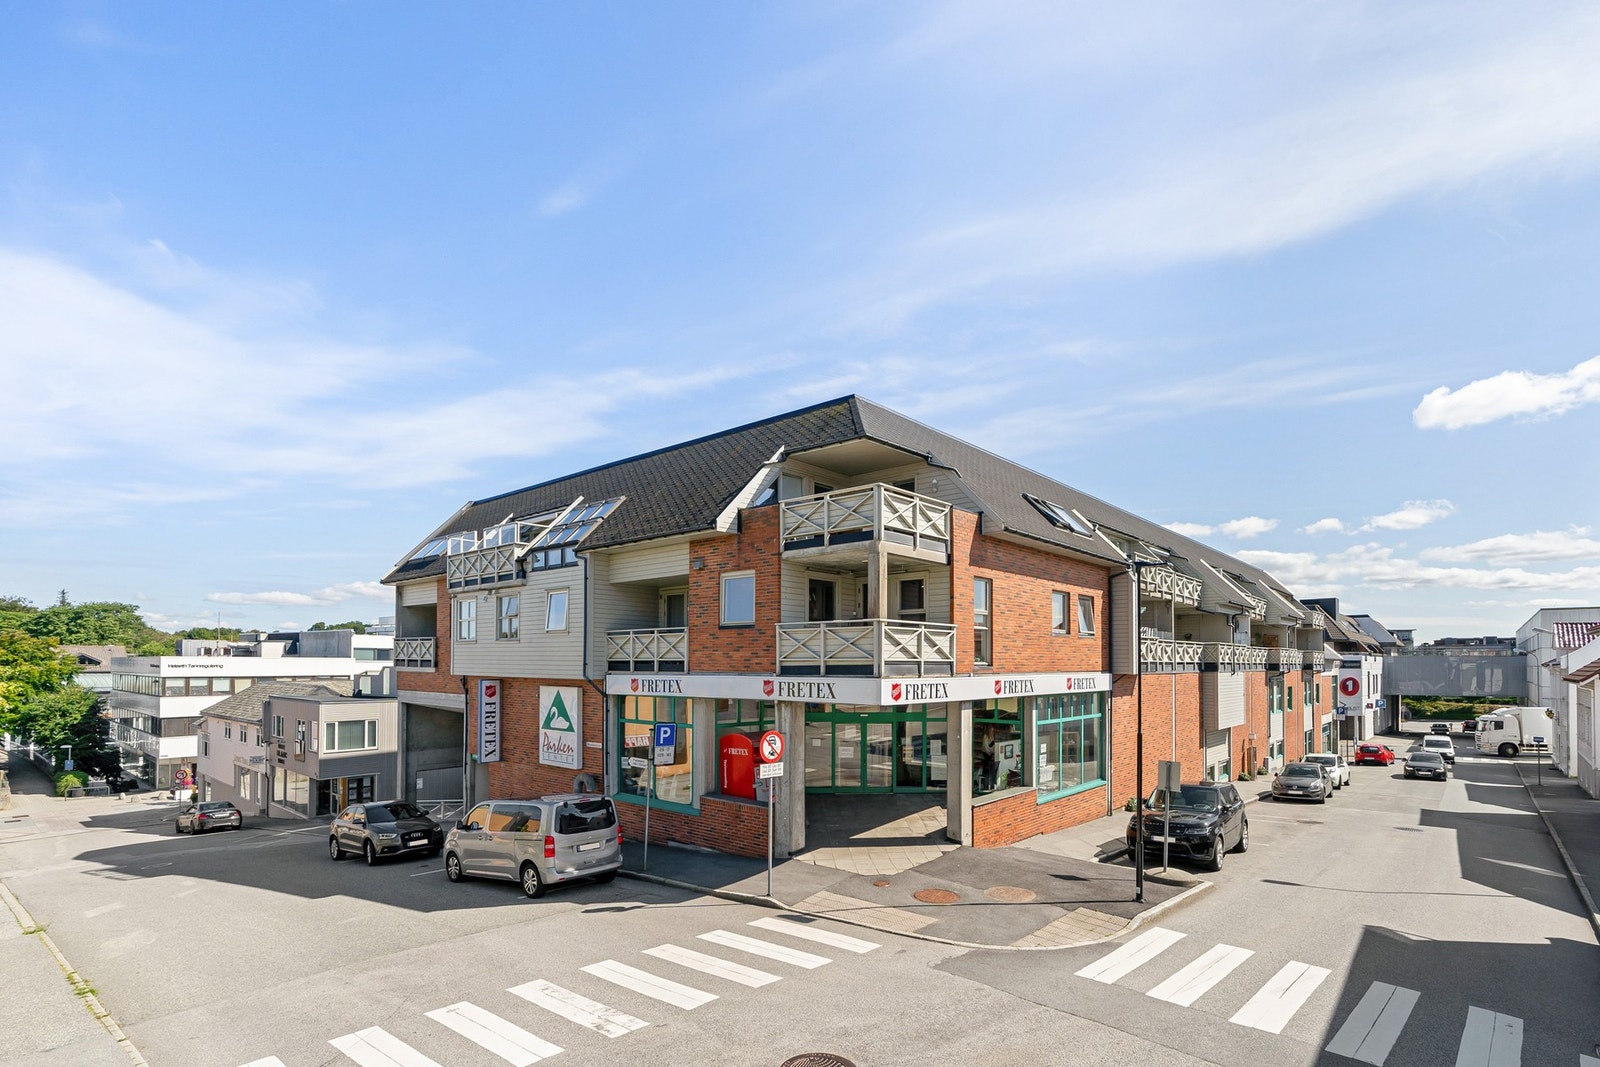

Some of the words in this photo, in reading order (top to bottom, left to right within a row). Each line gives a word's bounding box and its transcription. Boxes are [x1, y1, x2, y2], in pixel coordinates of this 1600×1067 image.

[642, 679, 682, 693] FRETEX
[778, 682, 836, 699] FRETEX
[905, 682, 948, 700] FRETEX
[1004, 679, 1034, 694] FRETEX
[1074, 677, 1096, 690] FRETEX
[485, 702, 497, 758] FRETEX
[660, 727, 670, 744] P
[543, 732, 574, 754] Parken
[728, 747, 748, 756] FRETEX
